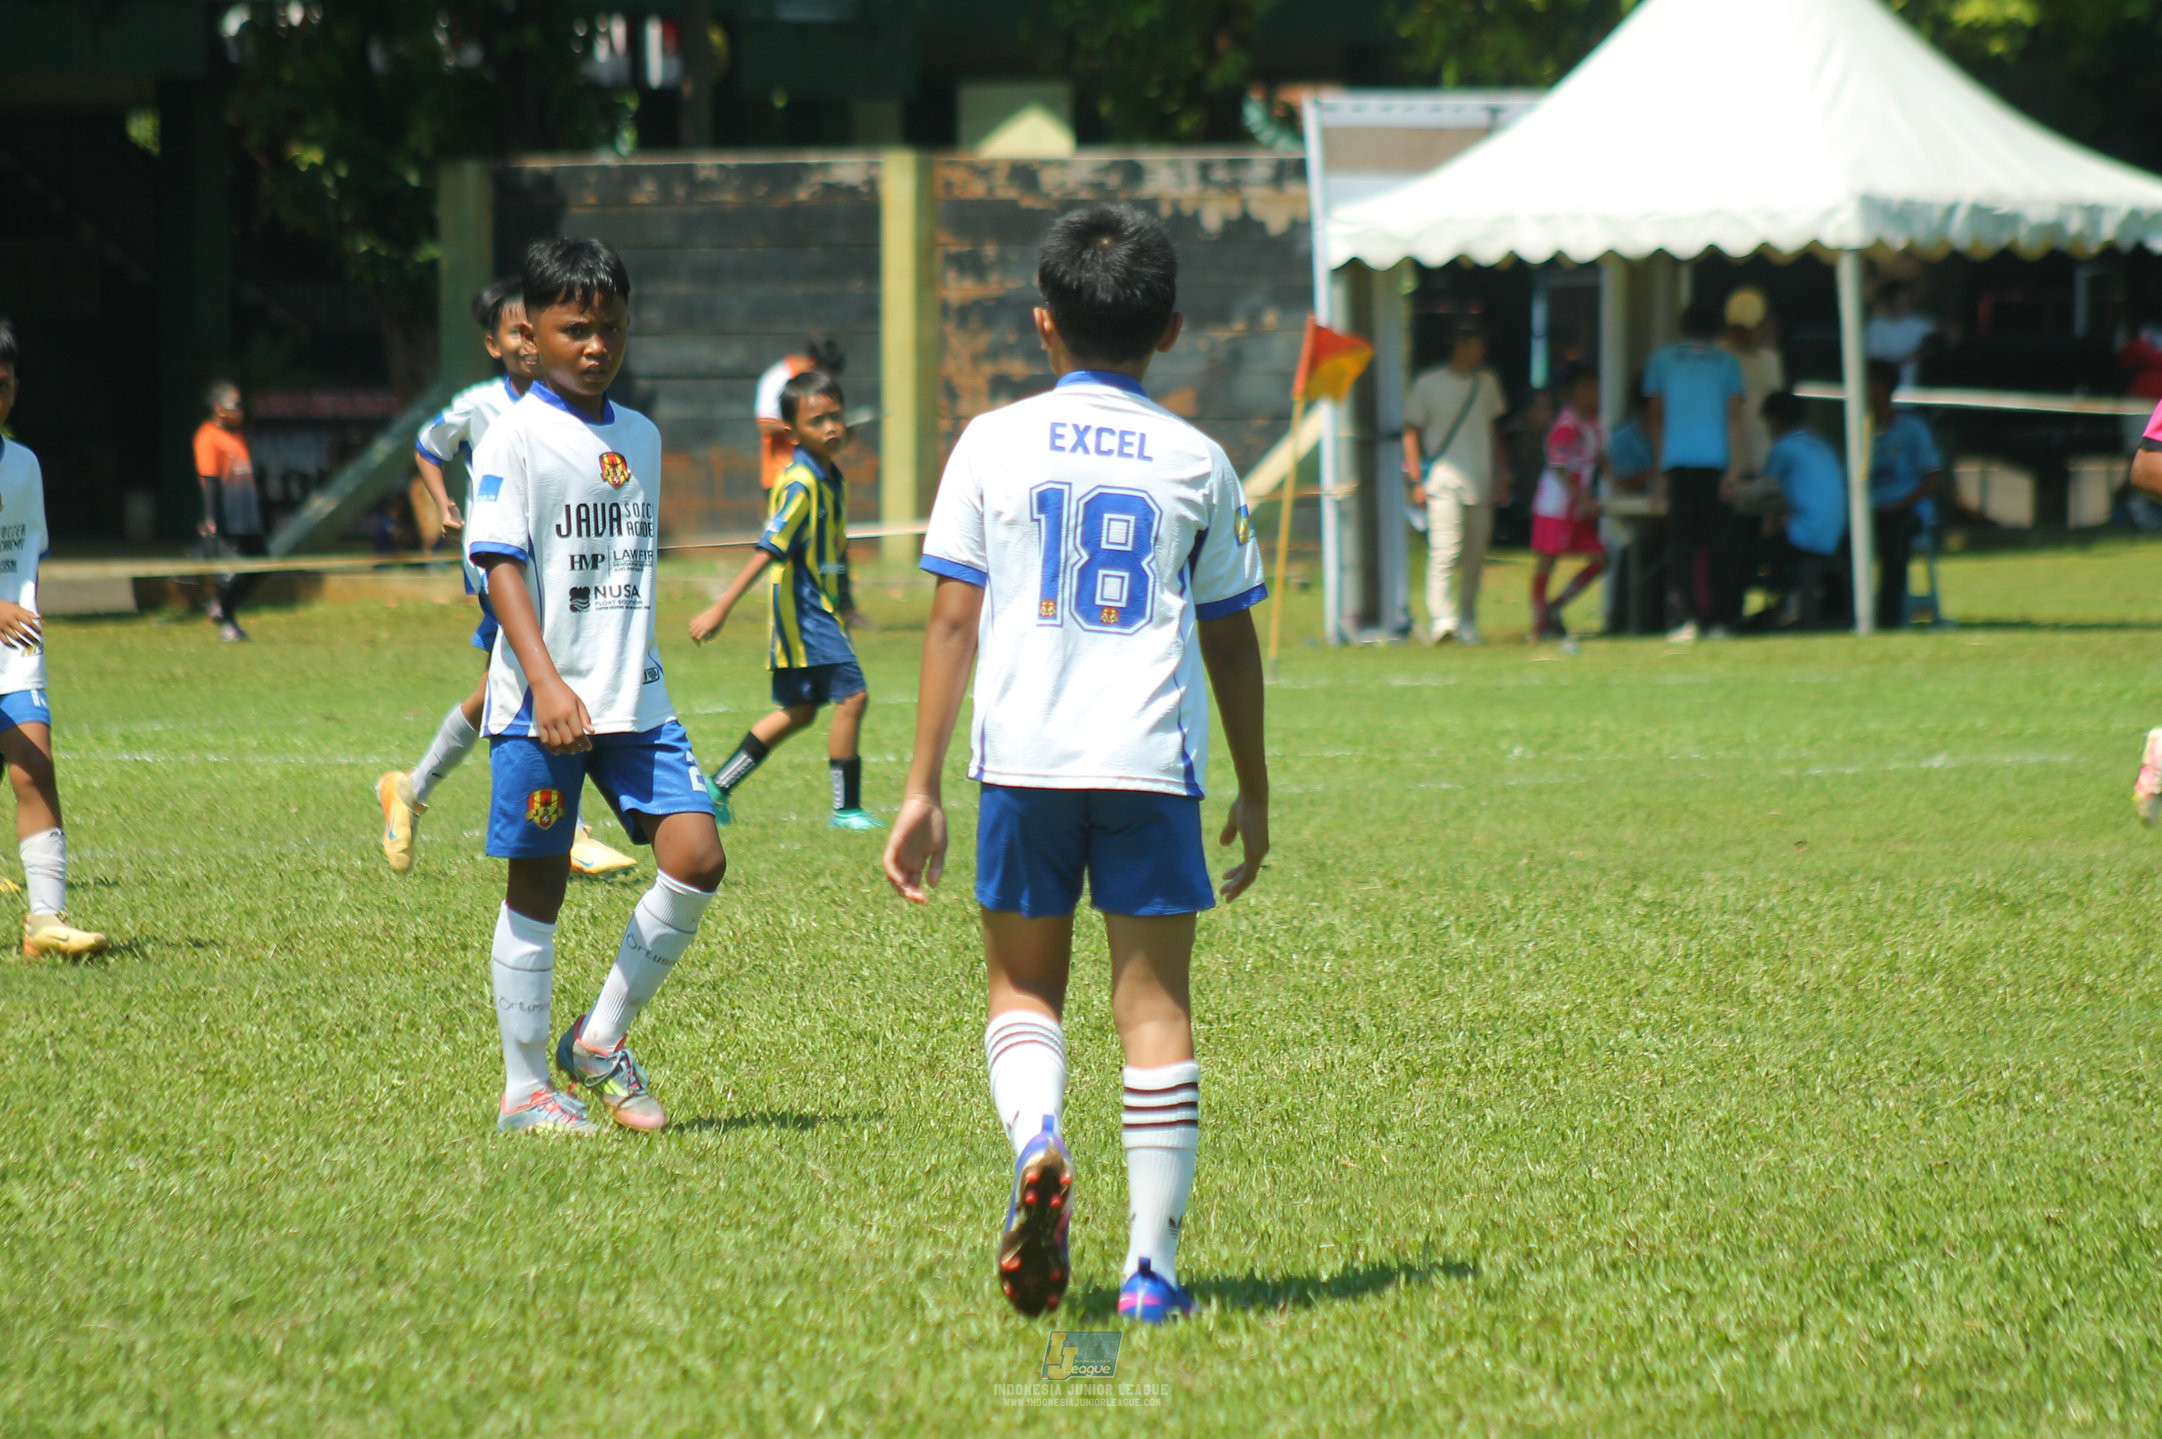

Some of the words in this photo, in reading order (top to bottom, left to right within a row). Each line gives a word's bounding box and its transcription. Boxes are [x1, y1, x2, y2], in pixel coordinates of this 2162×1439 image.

[1048, 421, 1154, 462] EXCEL
[556, 502, 623, 538] JAVA
[569, 553, 606, 571] HMP
[1029, 480, 1164, 636] 18
[593, 584, 641, 600] NUSA
